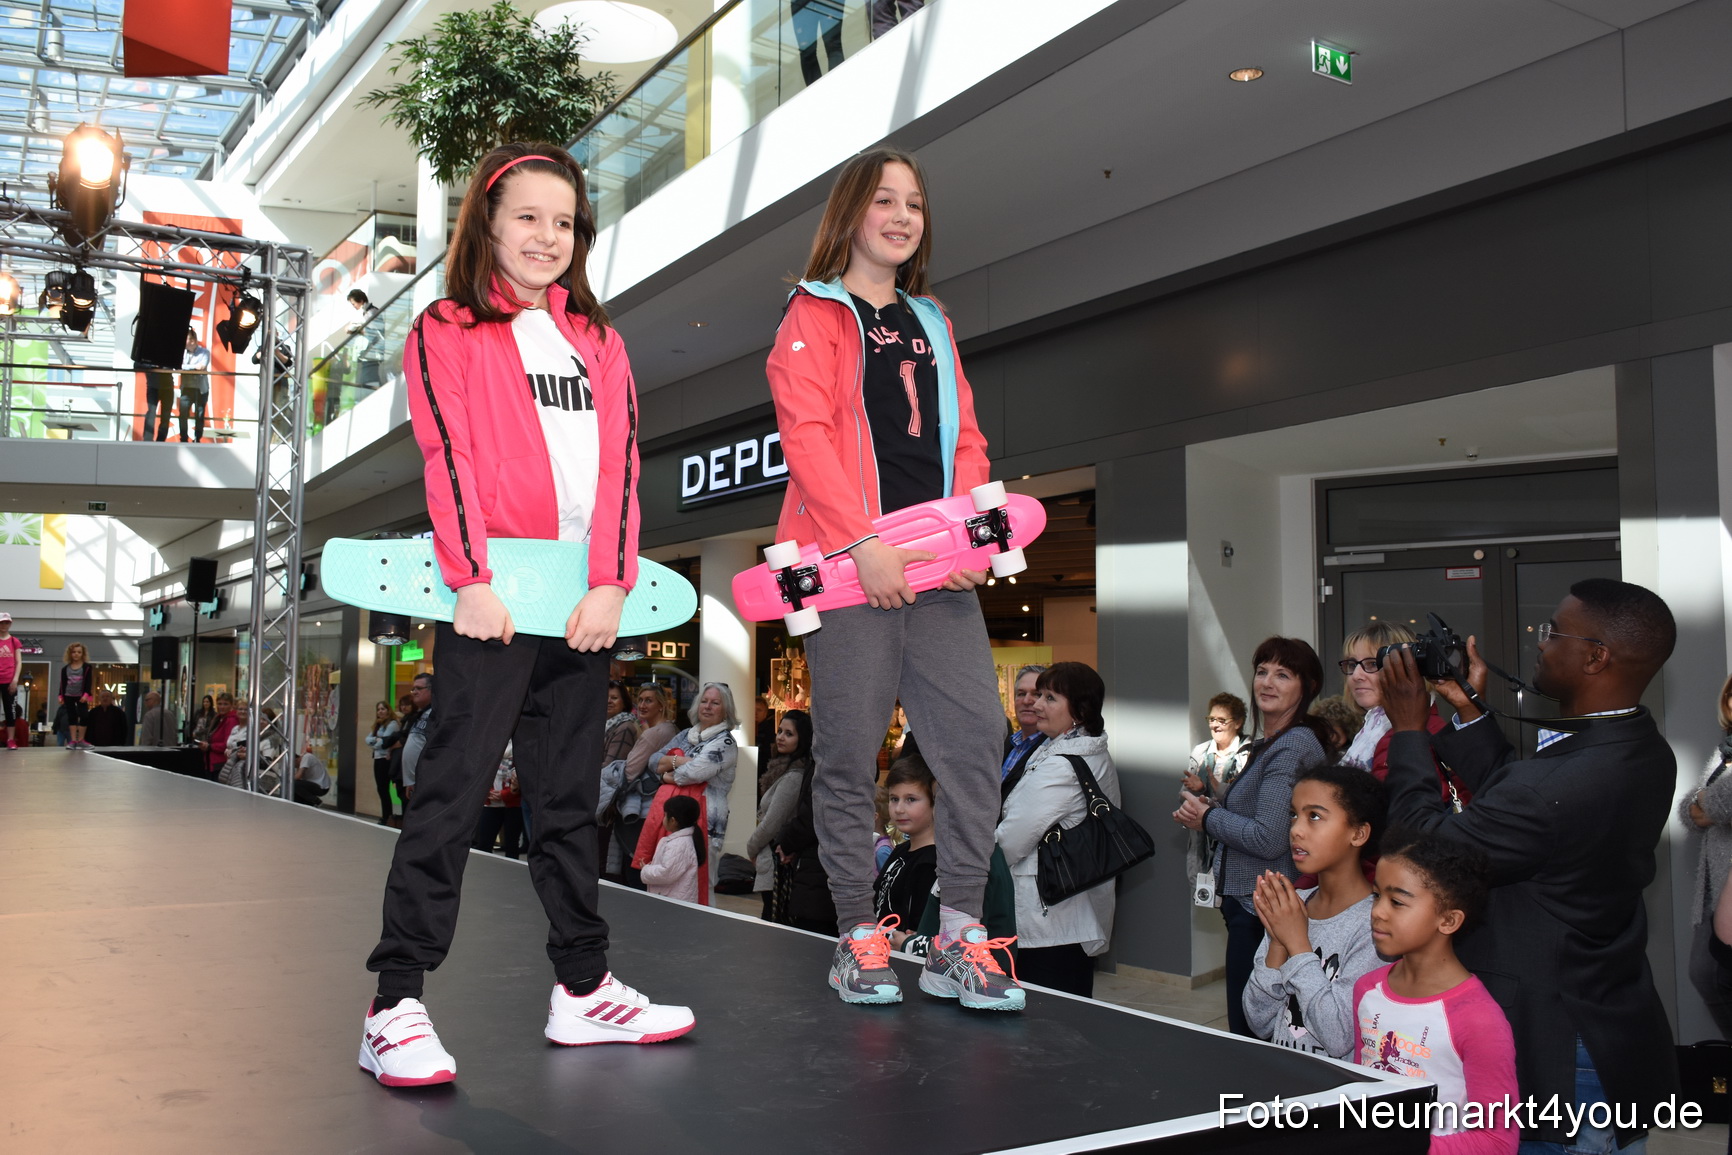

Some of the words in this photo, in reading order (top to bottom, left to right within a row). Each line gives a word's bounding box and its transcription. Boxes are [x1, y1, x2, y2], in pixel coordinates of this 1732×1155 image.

[867, 326, 904, 353] UST
[899, 360, 921, 438] 1
[647, 641, 690, 658] POT
